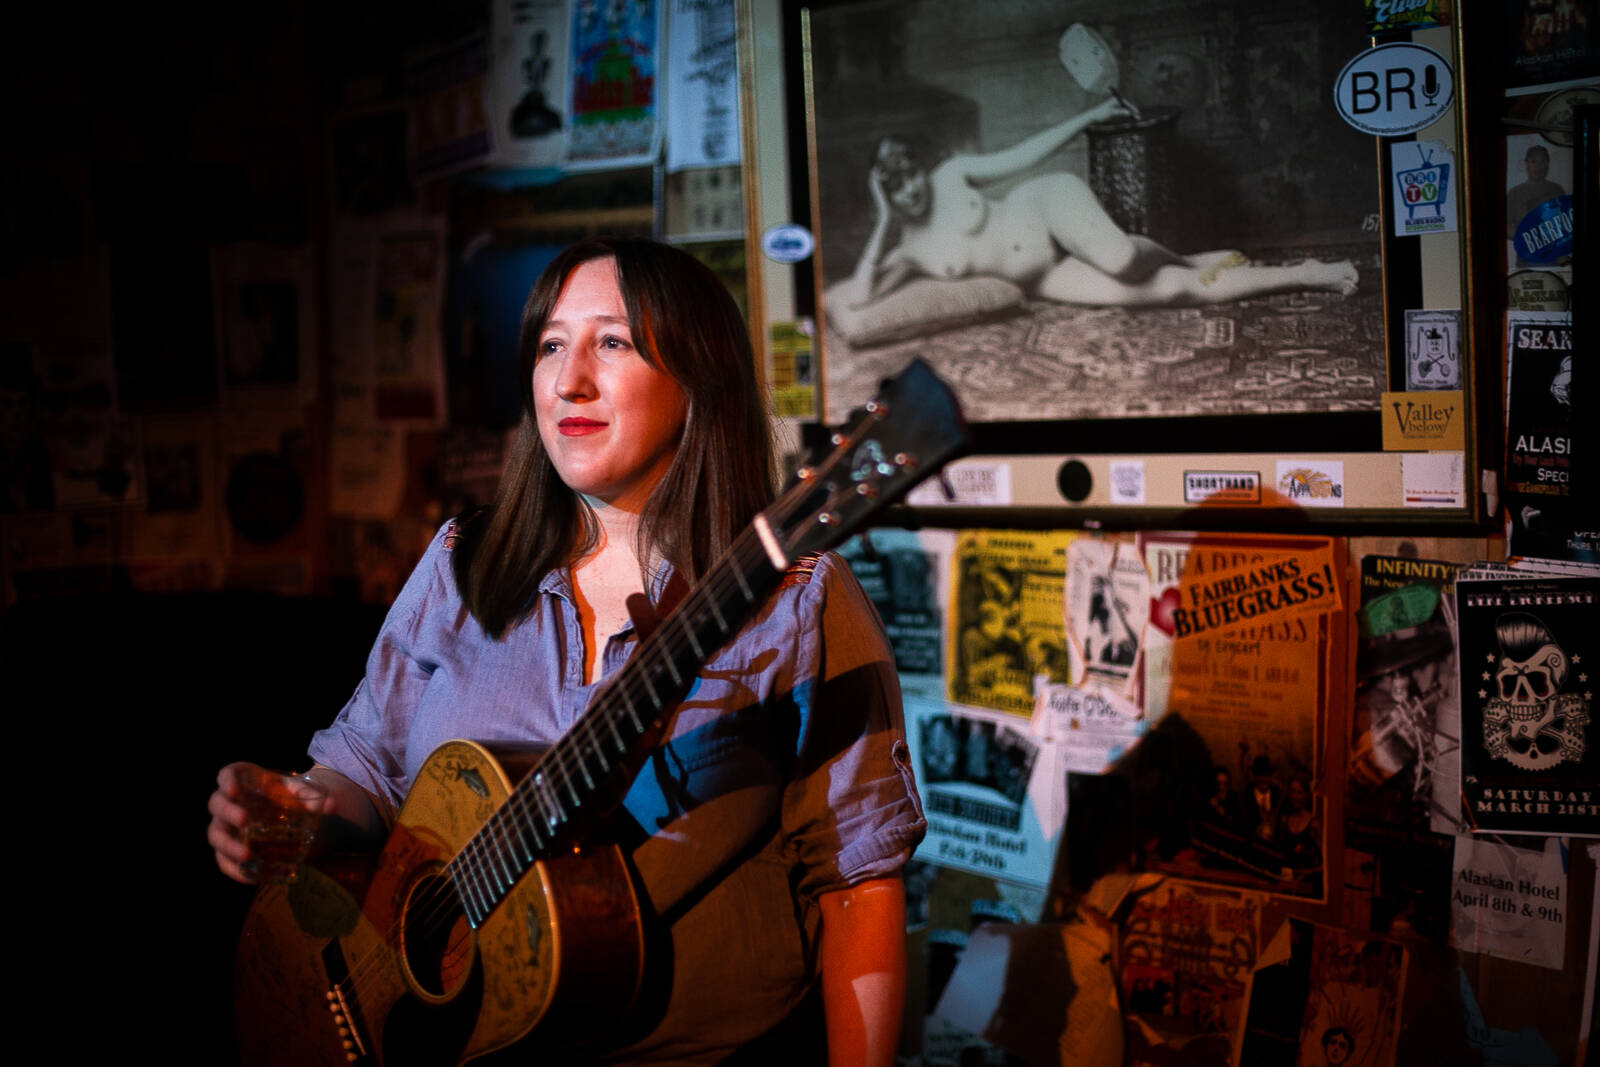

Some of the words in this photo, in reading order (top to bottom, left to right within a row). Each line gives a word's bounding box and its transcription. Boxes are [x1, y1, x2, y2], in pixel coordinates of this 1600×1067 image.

[1406, 183, 1437, 203] TV
[1393, 402, 1454, 433] Valley
[1189, 557, 1301, 607] FAIRBANKS
[1172, 564, 1336, 639] BLUEGRASS!
[1477, 800, 1551, 814] MARCH
[1557, 804, 1600, 816] 21ST
[1483, 787, 1593, 802] SATURDAY
[1459, 868, 1514, 892] Alaskan
[1519, 879, 1560, 901] Hotel
[1454, 888, 1489, 908] April
[1492, 896, 1517, 913] 8th
[1521, 903, 1533, 917] &
[1539, 906, 1563, 923] 9th
